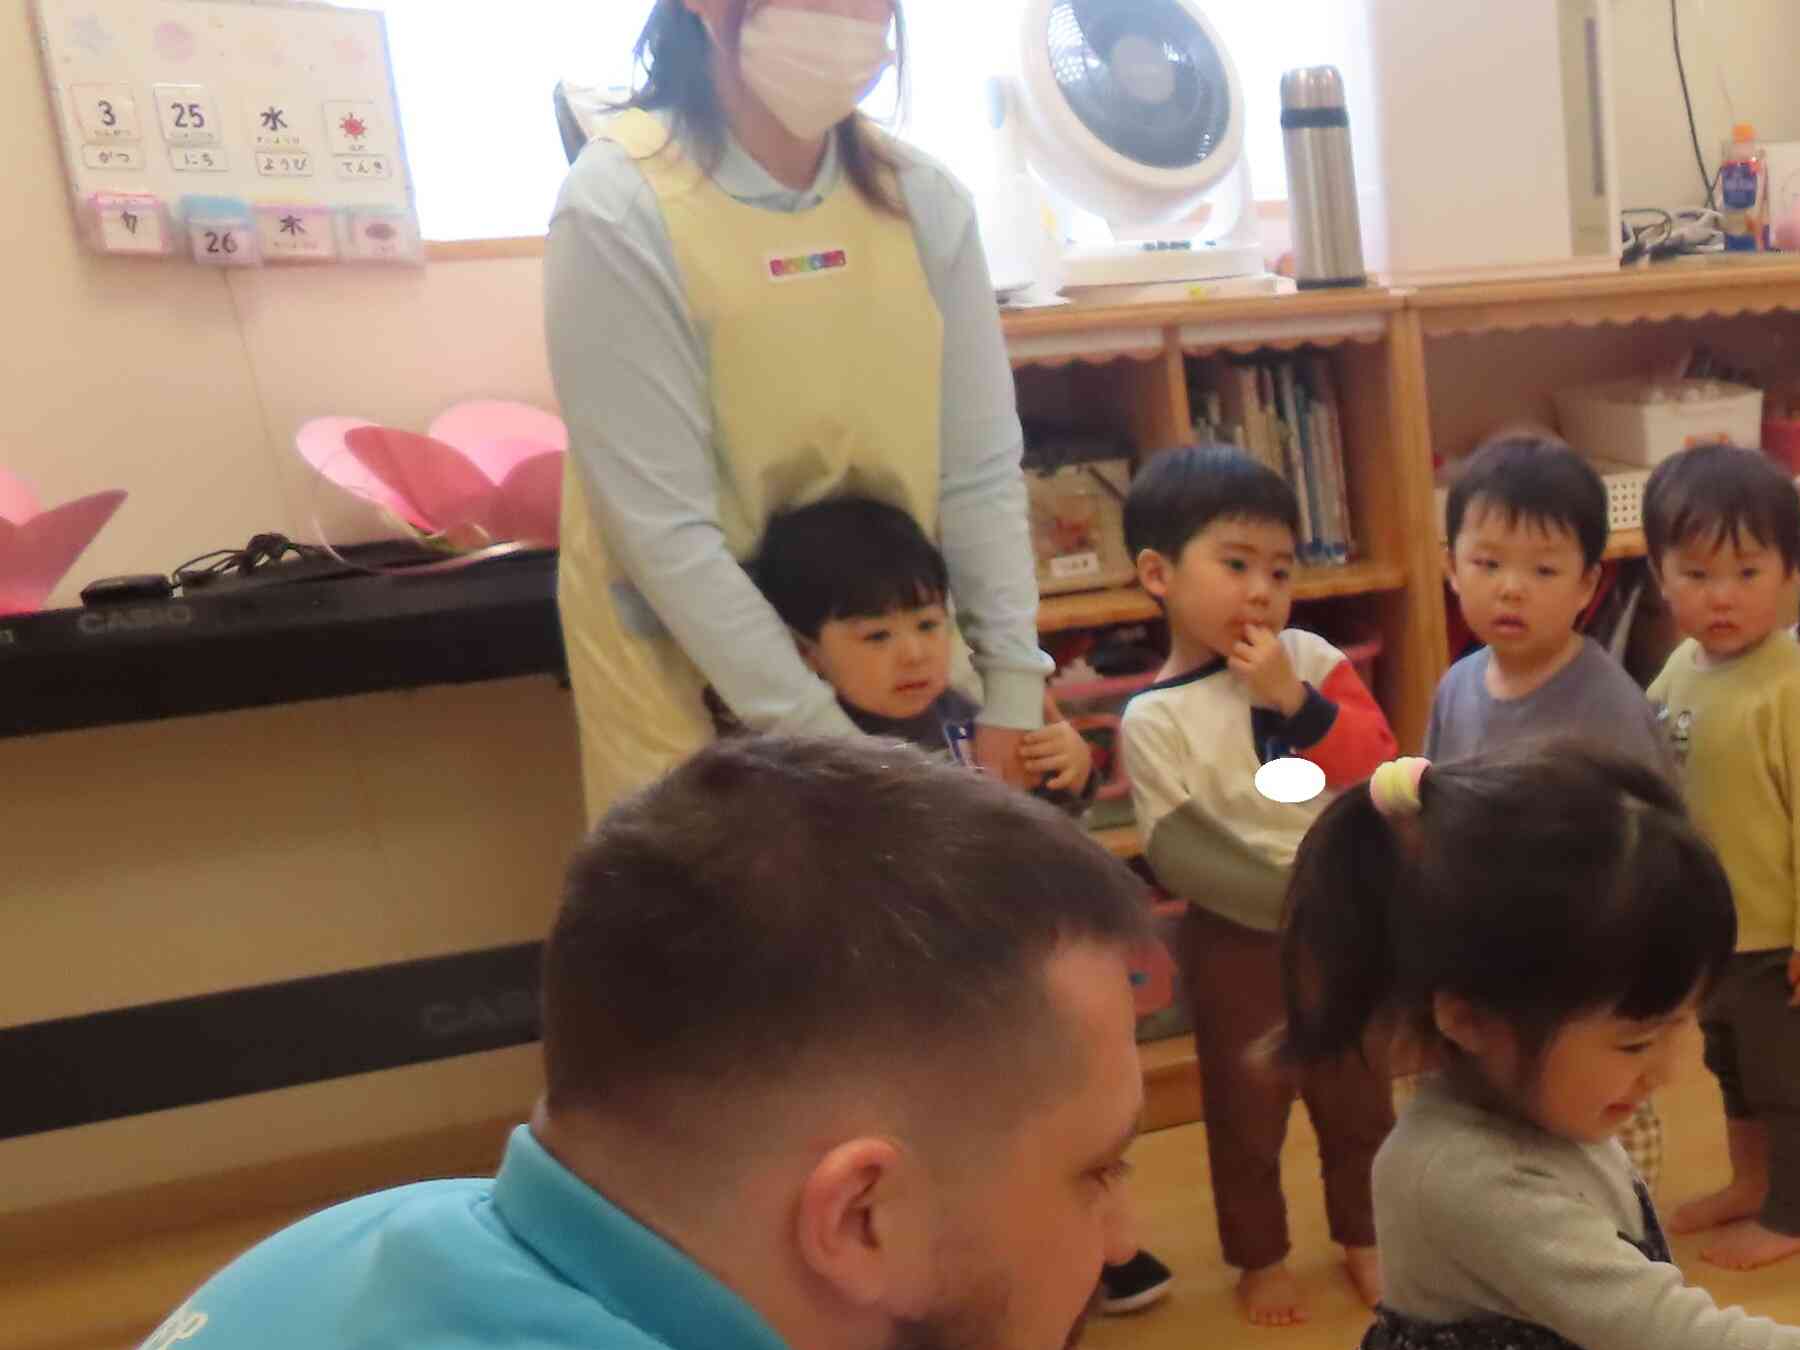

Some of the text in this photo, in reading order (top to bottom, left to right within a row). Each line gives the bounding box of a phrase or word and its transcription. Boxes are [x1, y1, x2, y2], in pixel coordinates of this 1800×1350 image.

[98, 100, 116, 126] 3
[171, 102, 205, 129] 25
[260, 106, 288, 132] 水
[98, 151, 131, 164] がつ
[184, 153, 214, 167] にち
[263, 157, 307, 171] ようび
[341, 161, 384, 175] てんき
[205, 231, 239, 254] 26
